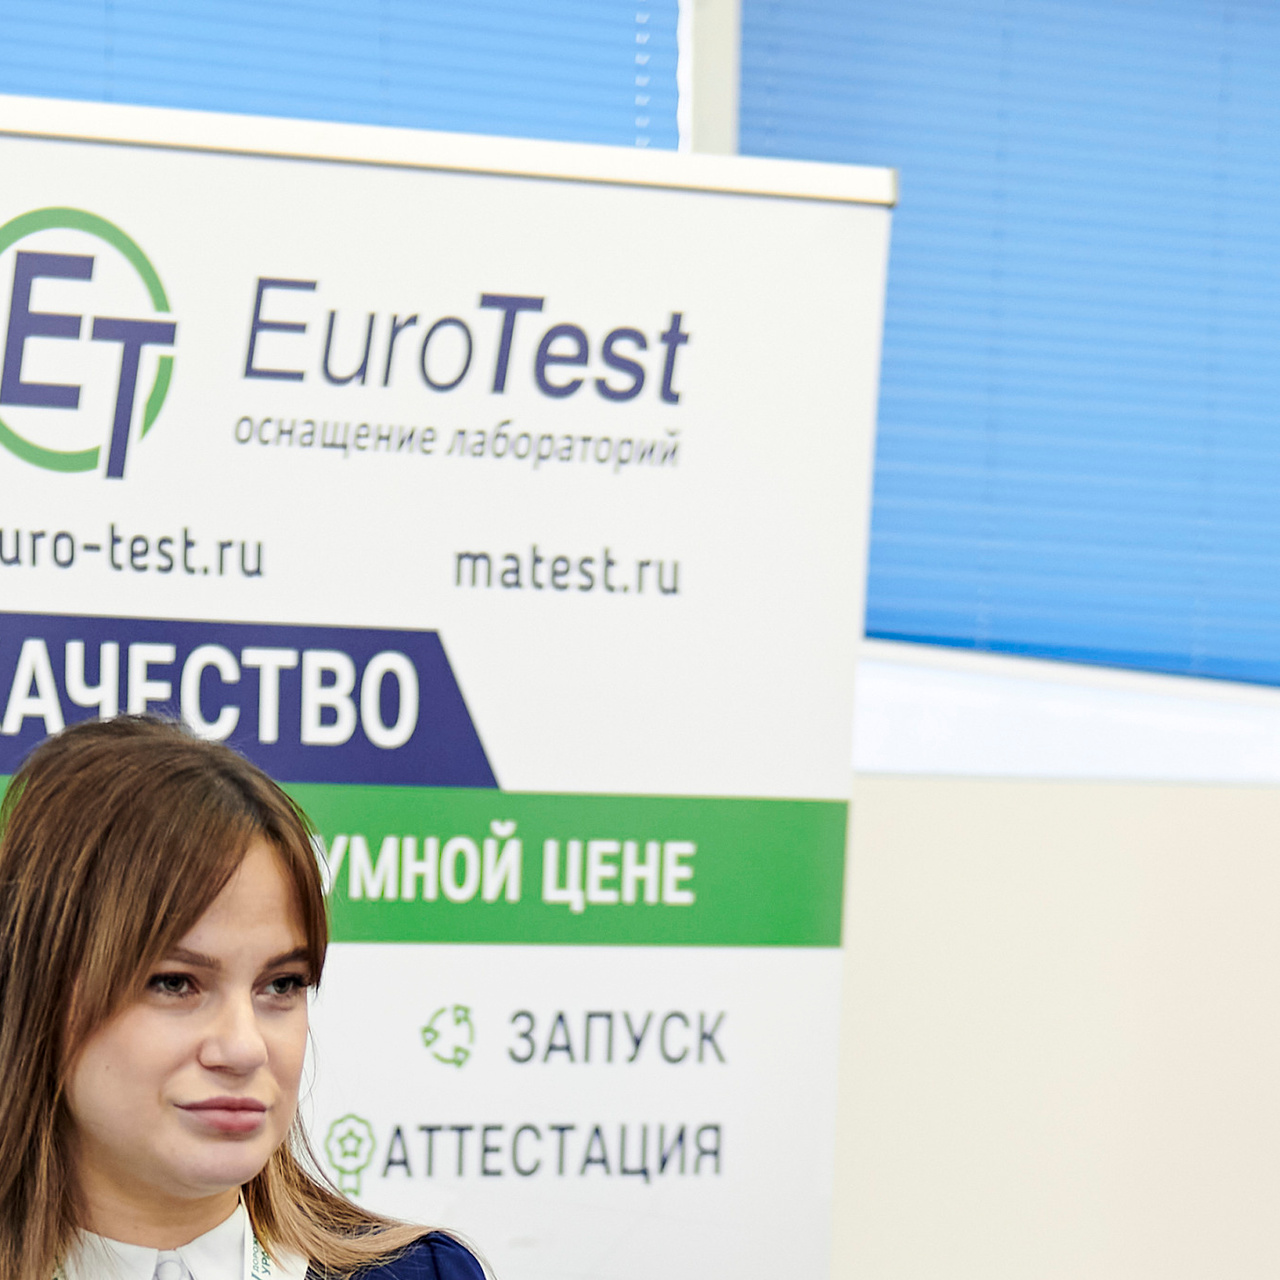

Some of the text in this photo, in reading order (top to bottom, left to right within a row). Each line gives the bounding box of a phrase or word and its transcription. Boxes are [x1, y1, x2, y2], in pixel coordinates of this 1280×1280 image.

[242, 275, 690, 406] EuroTest
[232, 411, 681, 474] оснащение лабораторий
[454, 543, 682, 598] matest.ru
[313, 819, 698, 914] УМНОЙ ЦЕНЕ
[506, 1009, 728, 1065] ЗАПУСК
[381, 1121, 724, 1180] АТТЕСТАЦИЯ
